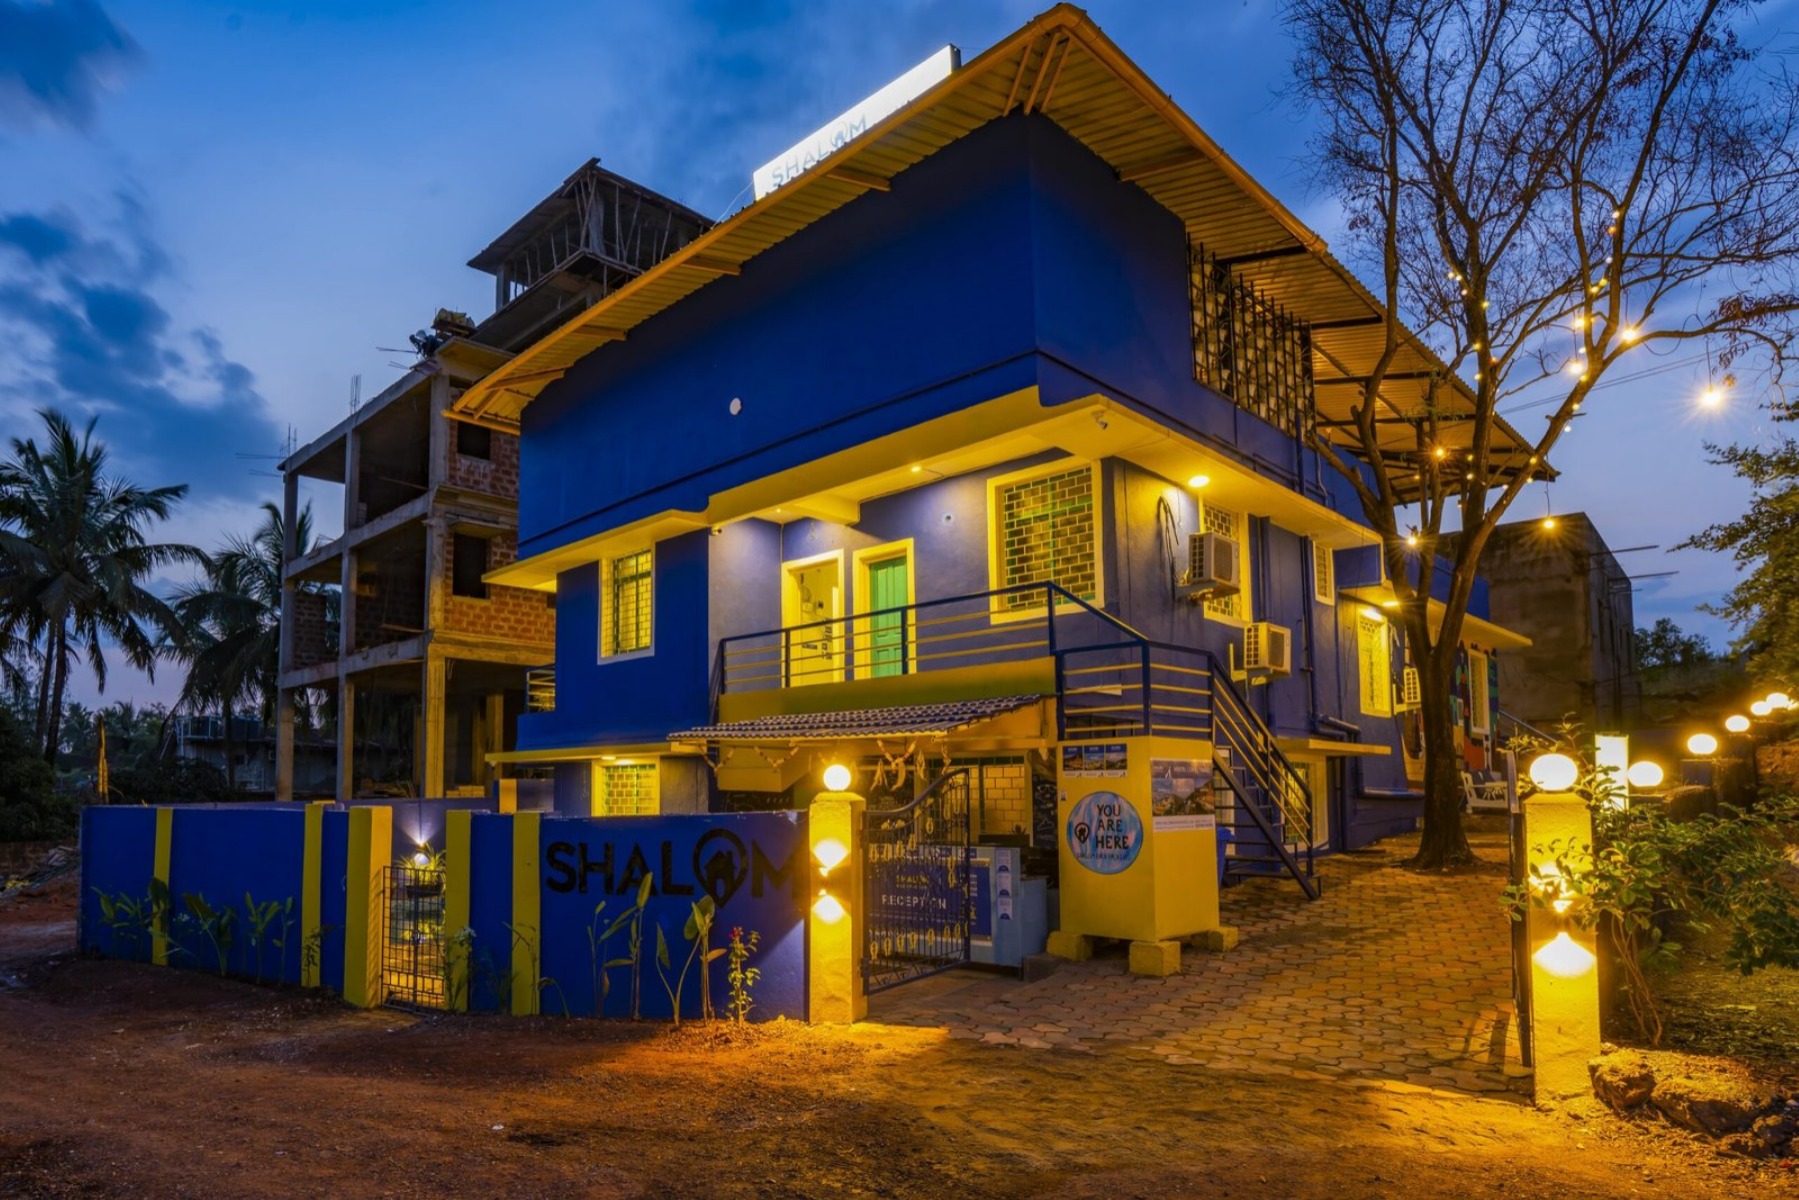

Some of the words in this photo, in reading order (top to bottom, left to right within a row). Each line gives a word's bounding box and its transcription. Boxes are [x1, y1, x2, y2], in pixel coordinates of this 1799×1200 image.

[1096, 804, 1121, 817] YOU
[1097, 819, 1123, 833] ARE
[1095, 835, 1130, 850] HERE
[546, 828, 807, 908] SHALOM
[881, 894, 947, 909] RECEPTON
